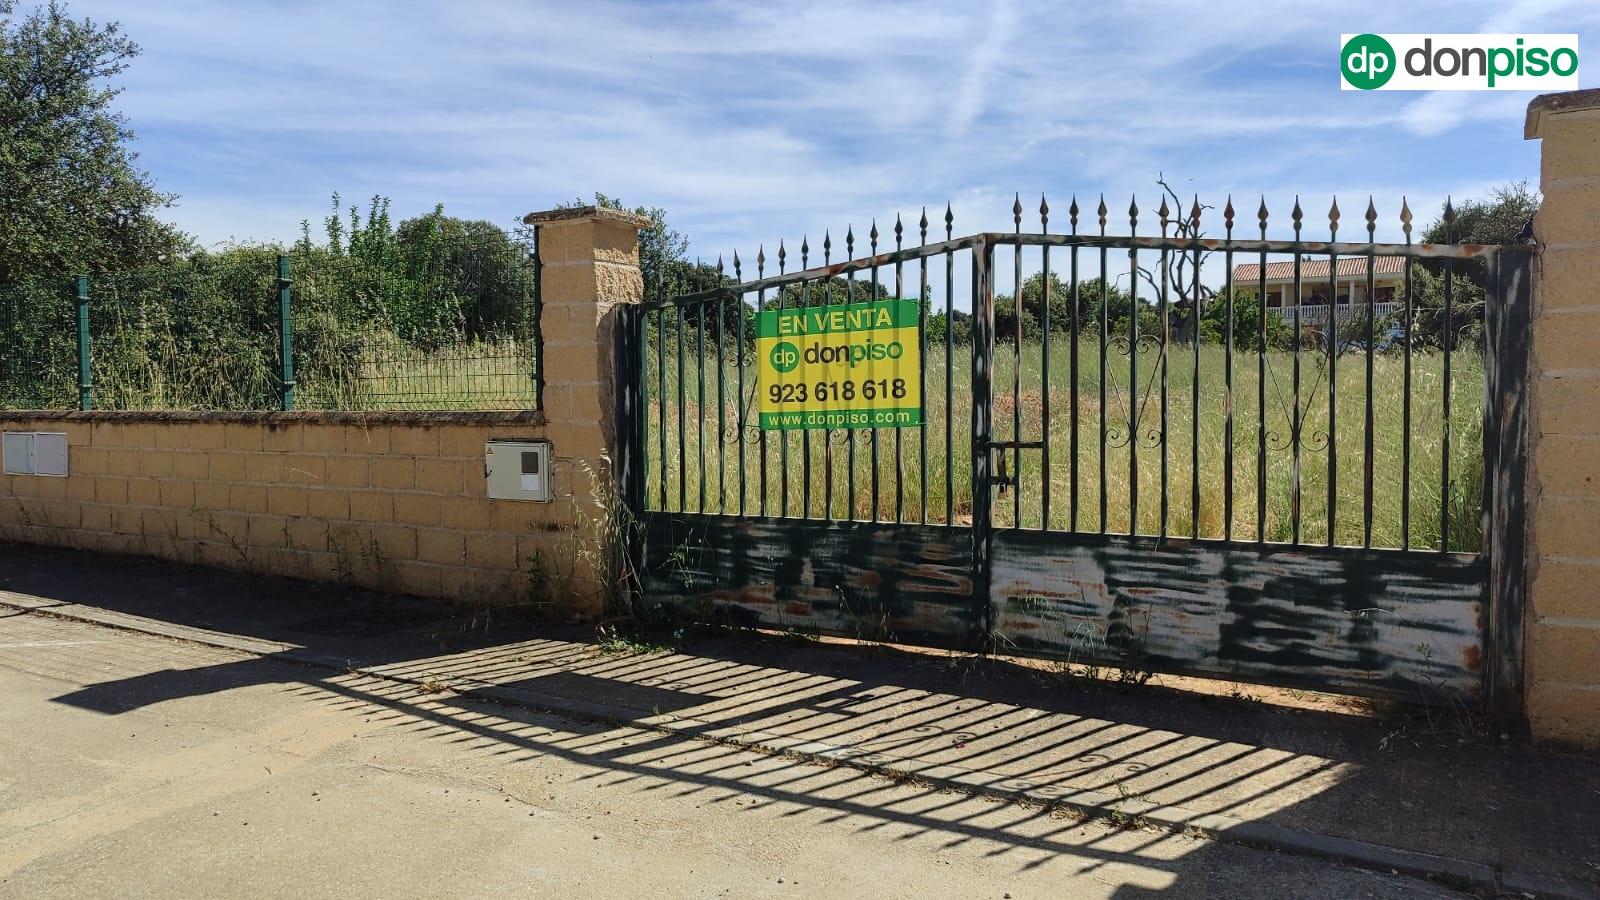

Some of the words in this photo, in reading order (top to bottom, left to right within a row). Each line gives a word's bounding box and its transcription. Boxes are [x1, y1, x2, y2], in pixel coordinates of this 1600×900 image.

[778, 314, 808, 334] EN
[815, 307, 893, 331] VENTA
[773, 348, 796, 368] dp
[804, 338, 904, 368] donpiso
[769, 383, 808, 404] 923
[814, 380, 856, 402] 618
[862, 378, 906, 401] 618
[768, 411, 910, 427] www.donpiso.com
